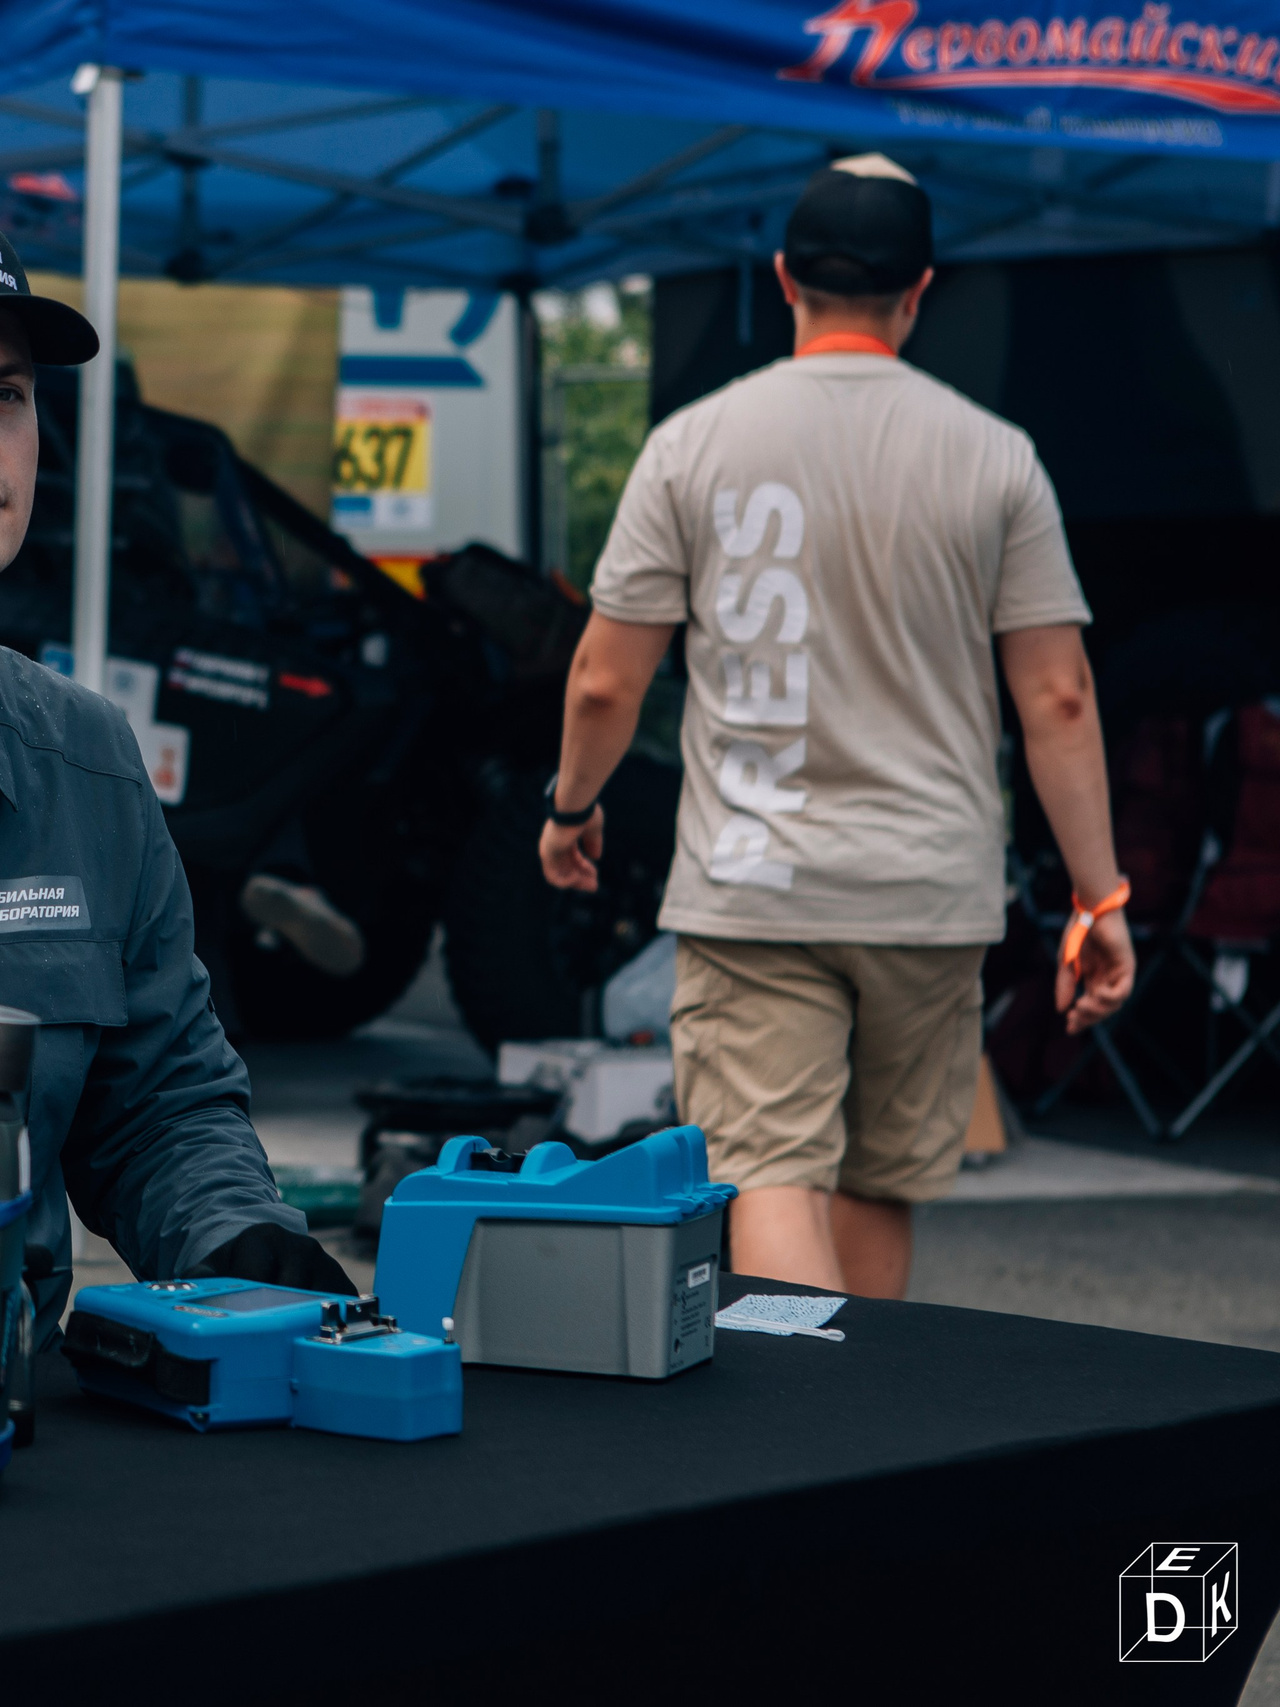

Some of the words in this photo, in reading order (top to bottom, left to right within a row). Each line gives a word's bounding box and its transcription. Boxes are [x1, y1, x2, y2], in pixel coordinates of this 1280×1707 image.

[777, 0, 1280, 86] Первомайски
[333, 424, 414, 490] 637
[710, 481, 810, 891] PRESS
